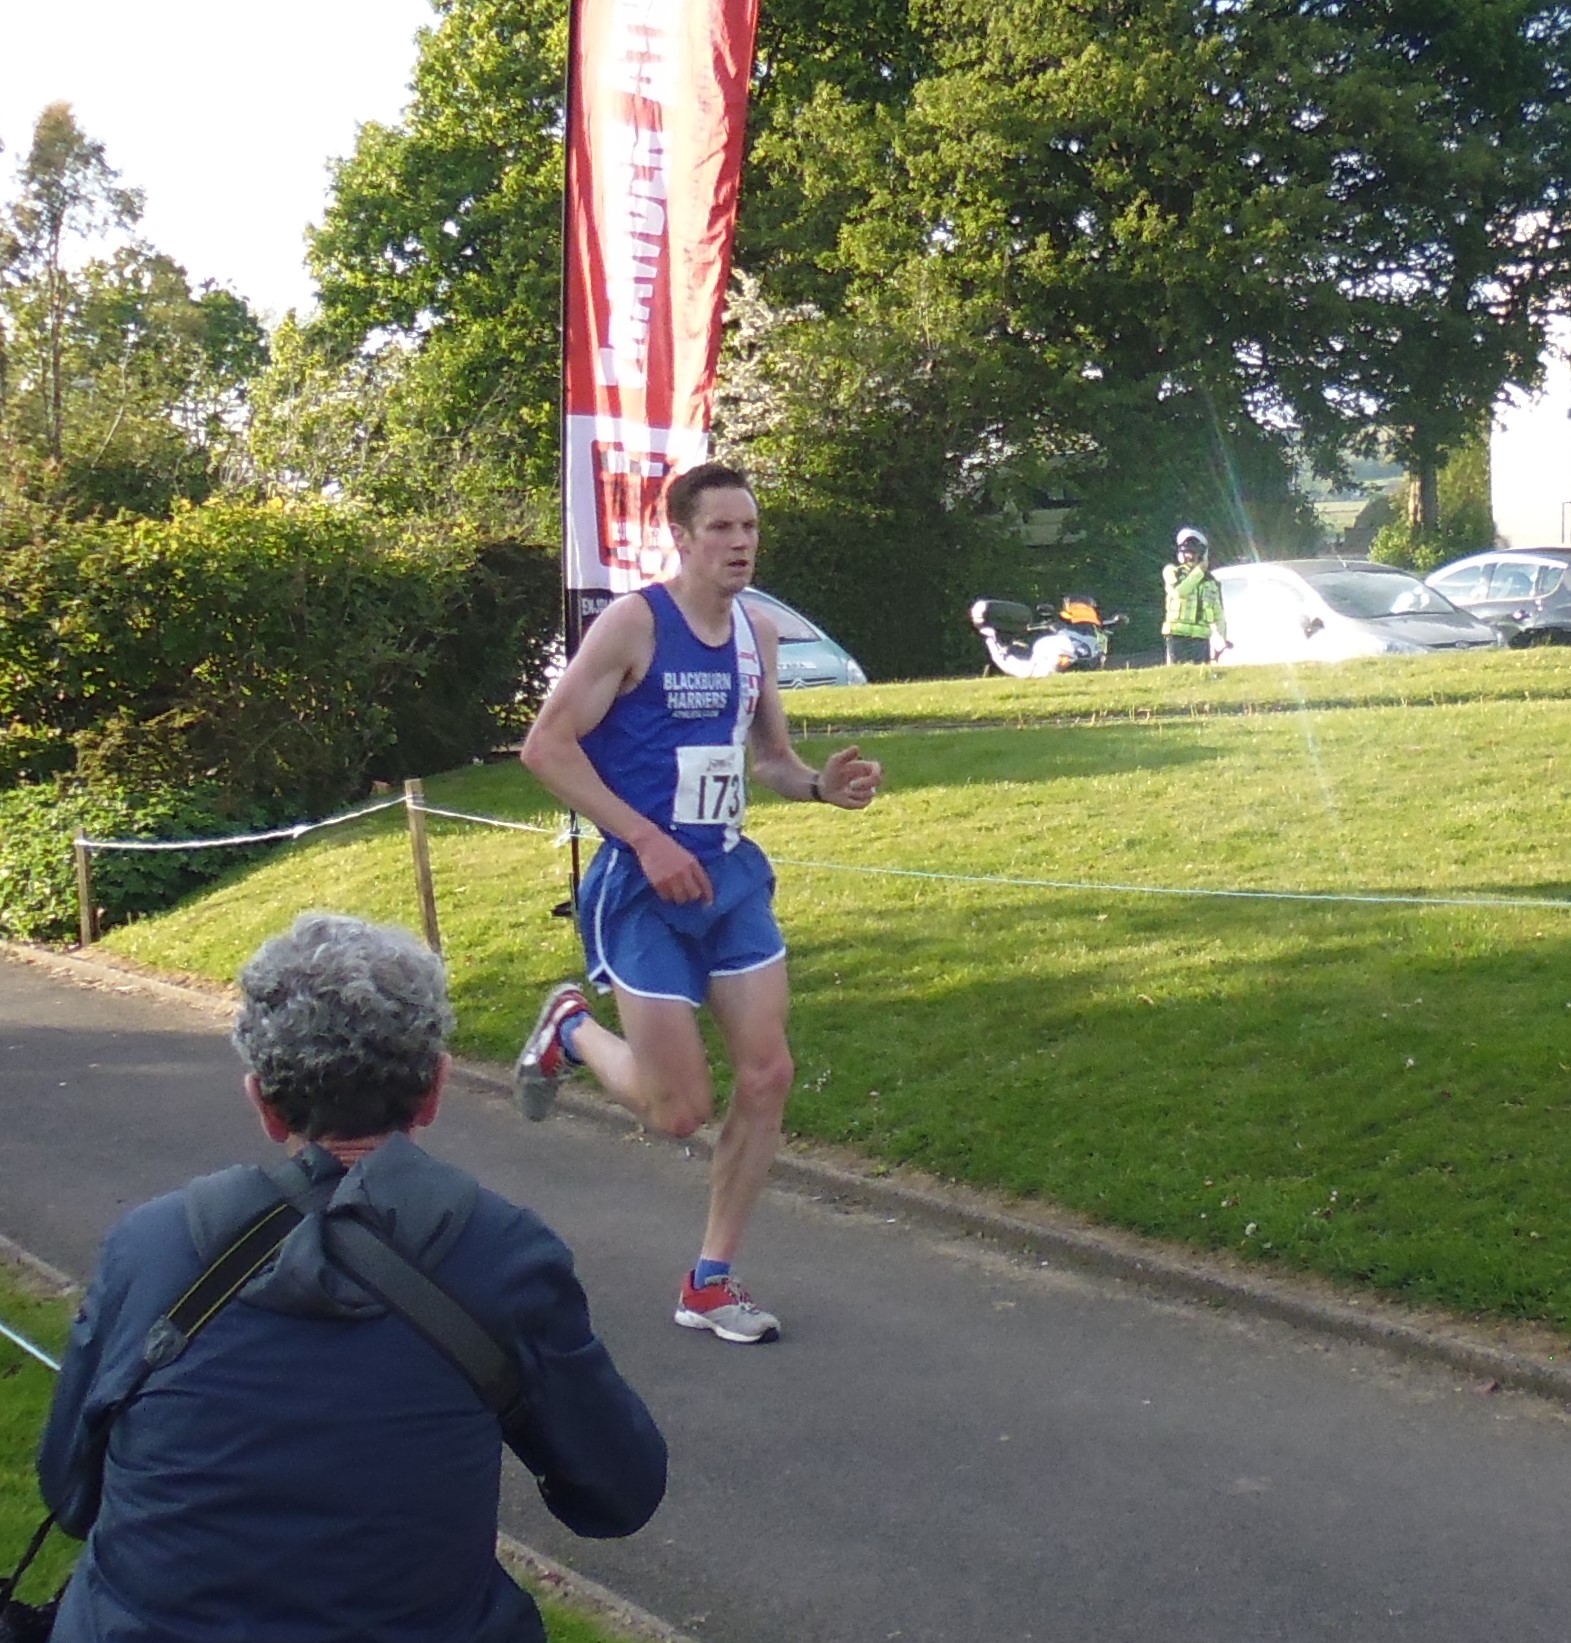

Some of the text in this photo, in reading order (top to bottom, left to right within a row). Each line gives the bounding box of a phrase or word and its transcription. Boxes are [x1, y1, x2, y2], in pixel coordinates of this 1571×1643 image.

[663, 672, 732, 690] BLACKBURN
[667, 691, 728, 709] HARRIERS
[697, 774, 740, 819] 173
